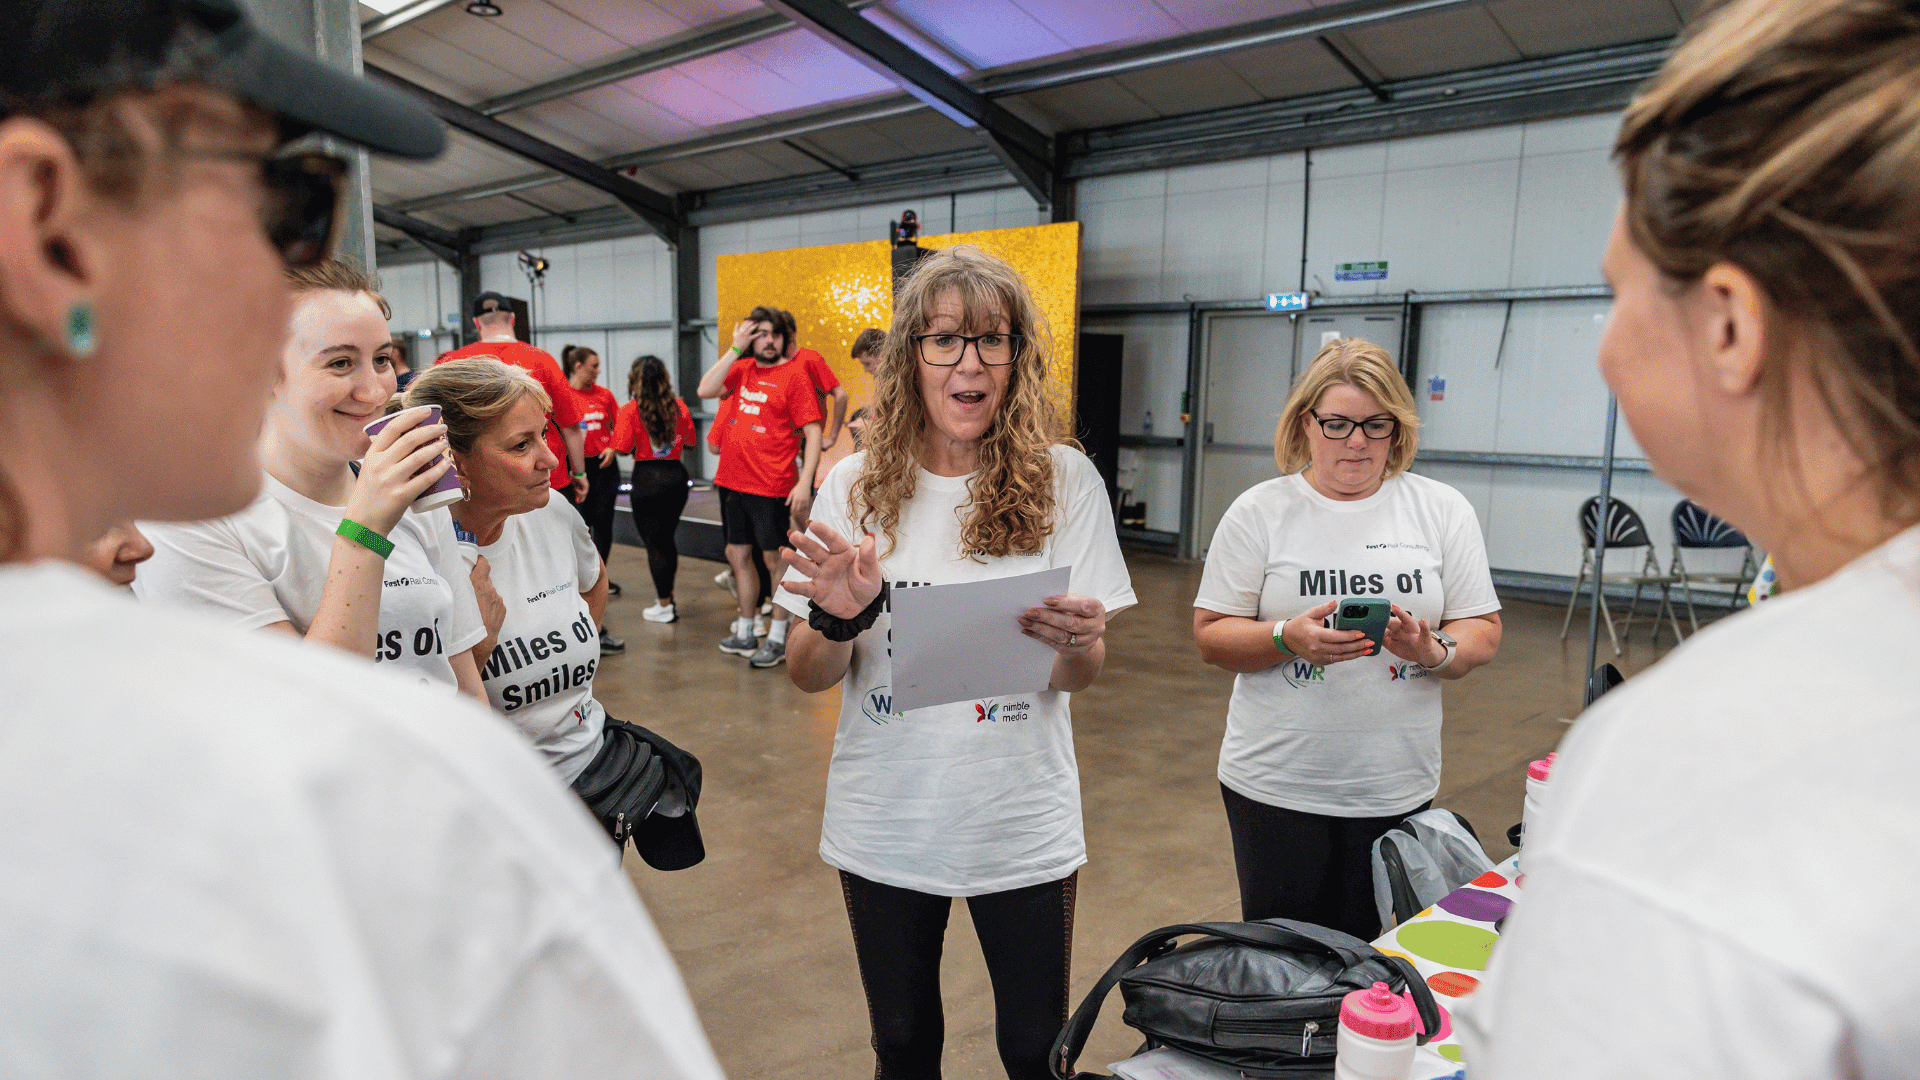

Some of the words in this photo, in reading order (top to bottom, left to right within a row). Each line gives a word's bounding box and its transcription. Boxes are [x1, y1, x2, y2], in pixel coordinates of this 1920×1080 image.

[384, 579, 401, 588] First
[410, 577, 422, 585] Rail
[1299, 569, 1385, 597] Miles
[1396, 568, 1423, 594] of
[527, 595, 540, 604] First
[480, 630, 567, 682] Miles
[571, 611, 594, 644] of
[502, 658, 596, 711] Smiles
[1002, 701, 1031, 712] nimble
[1002, 711, 1028, 723] media
